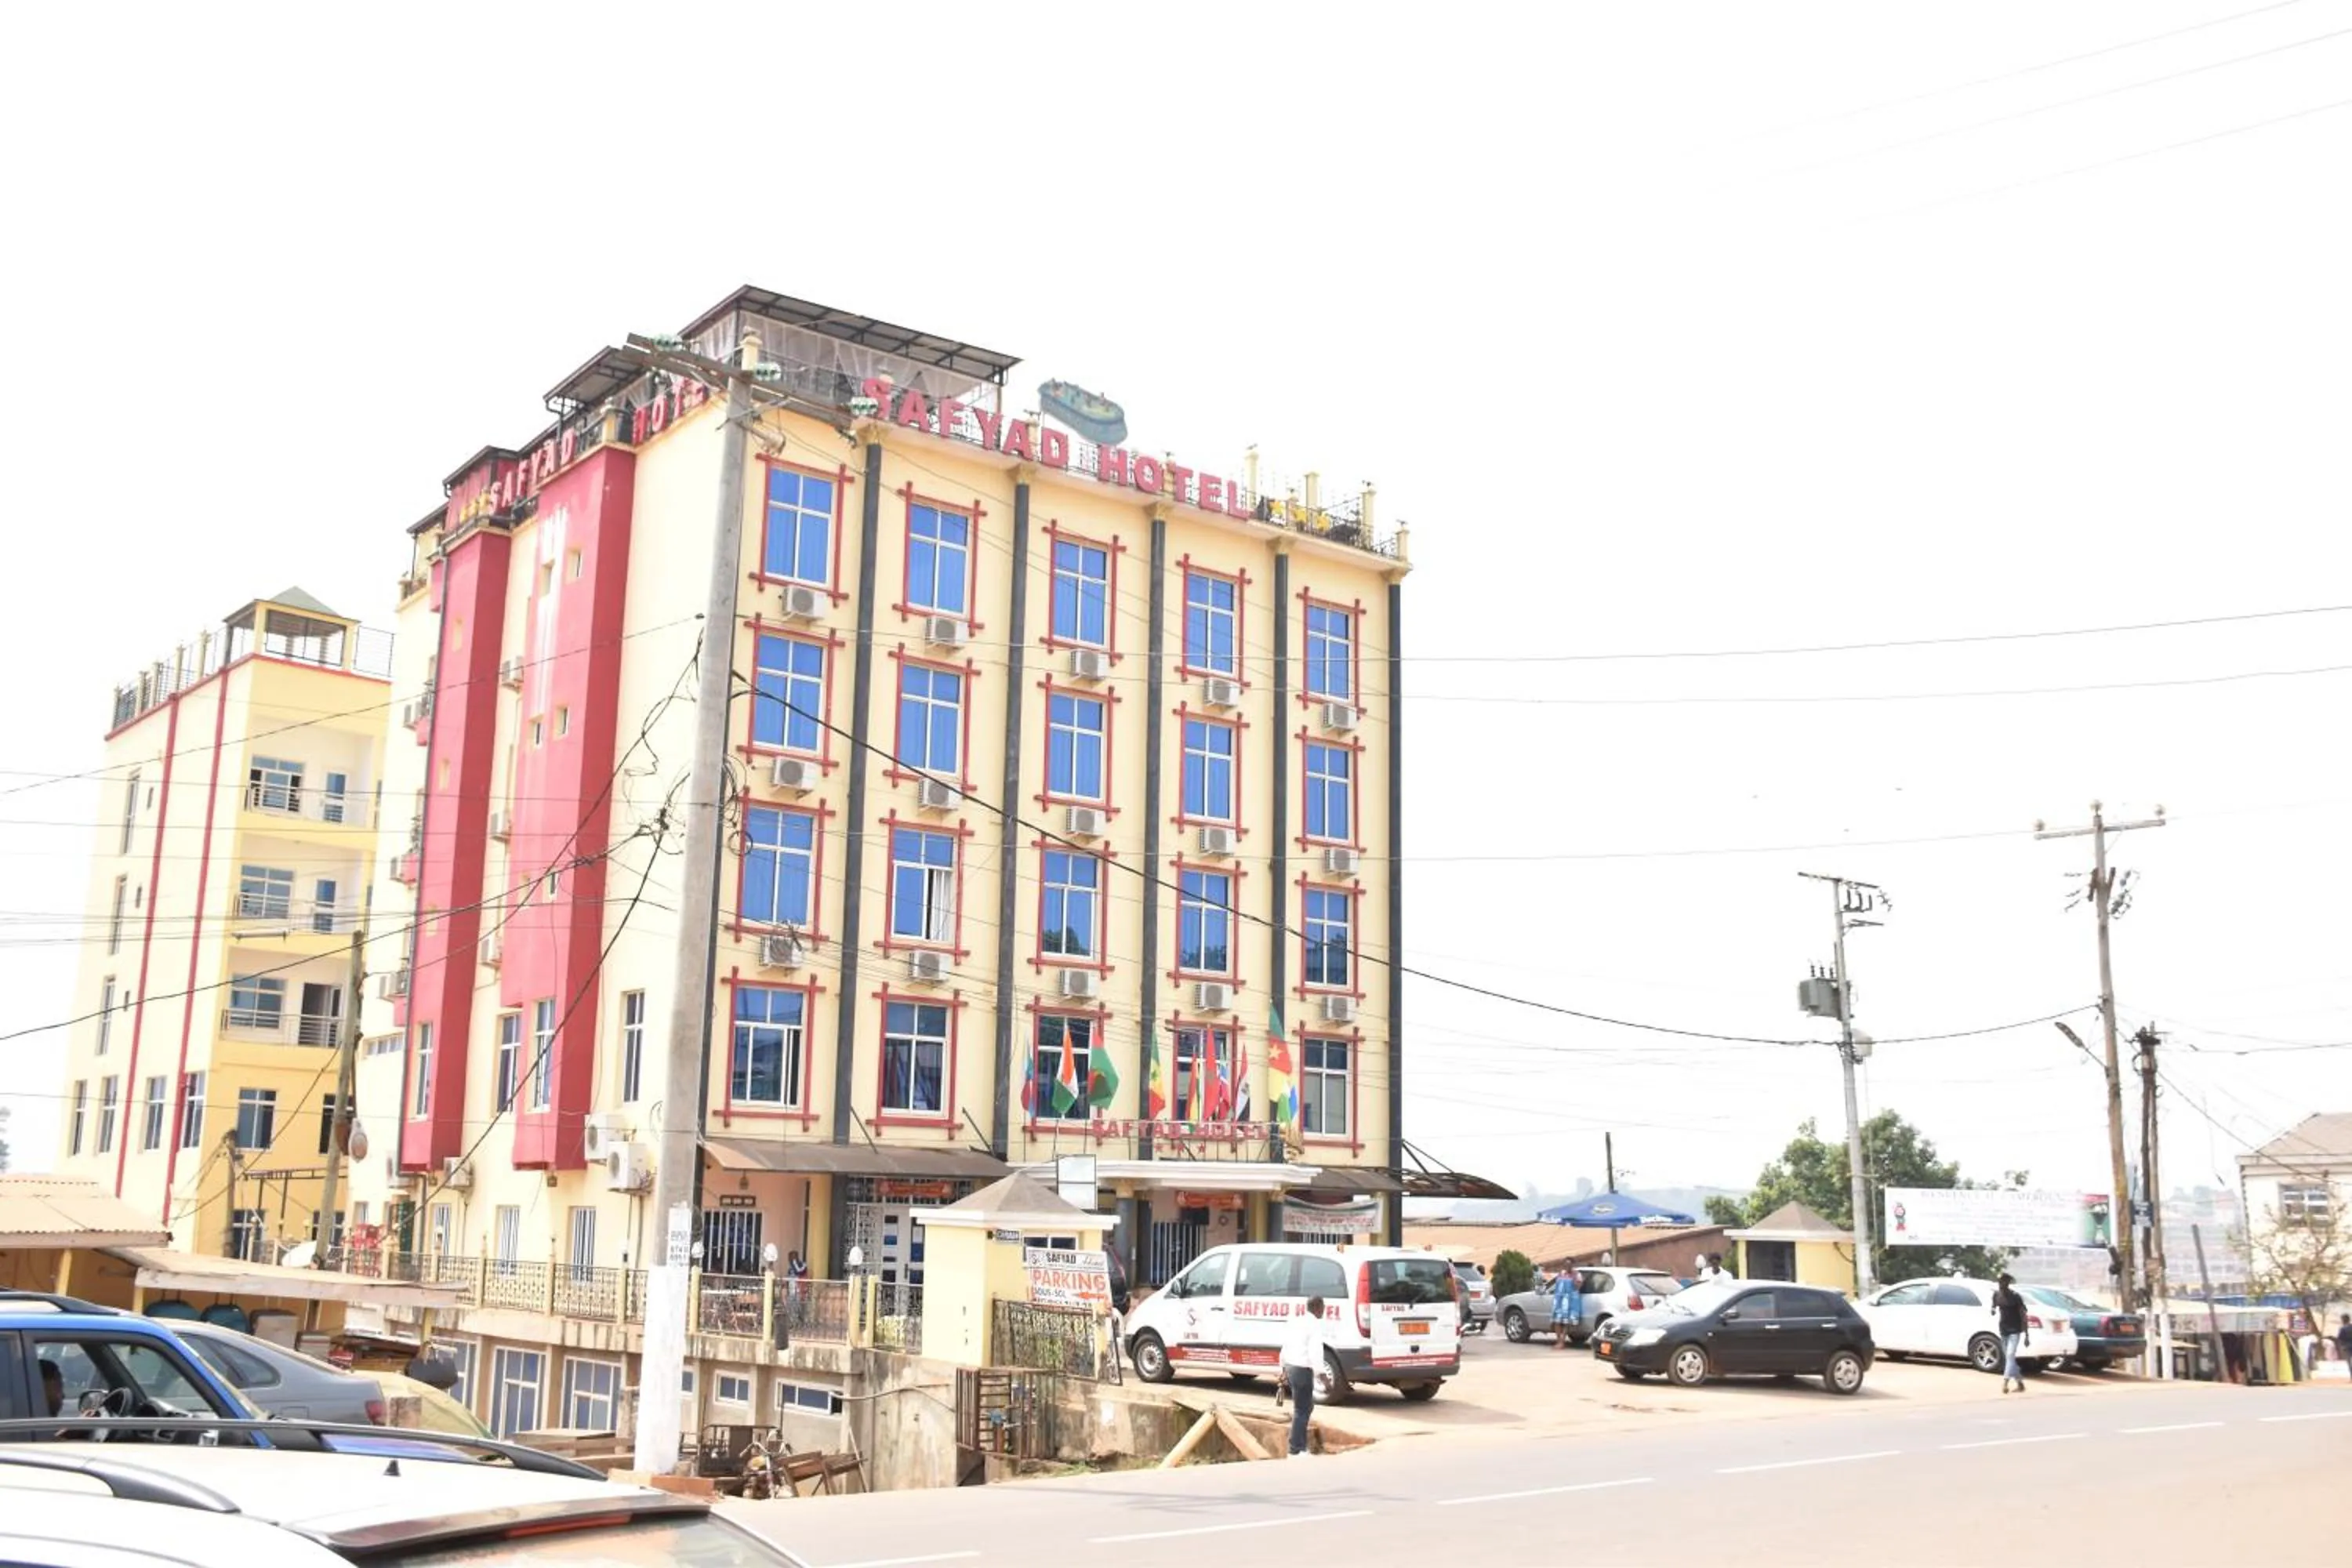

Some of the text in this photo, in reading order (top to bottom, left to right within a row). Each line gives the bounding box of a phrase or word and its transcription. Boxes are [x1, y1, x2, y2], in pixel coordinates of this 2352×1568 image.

[862, 378, 1253, 521] SAFYAD HOTEL
[1033, 1269, 1106, 1290] PARKING
[1233, 1300, 1341, 1321] SAFYAD HEL
